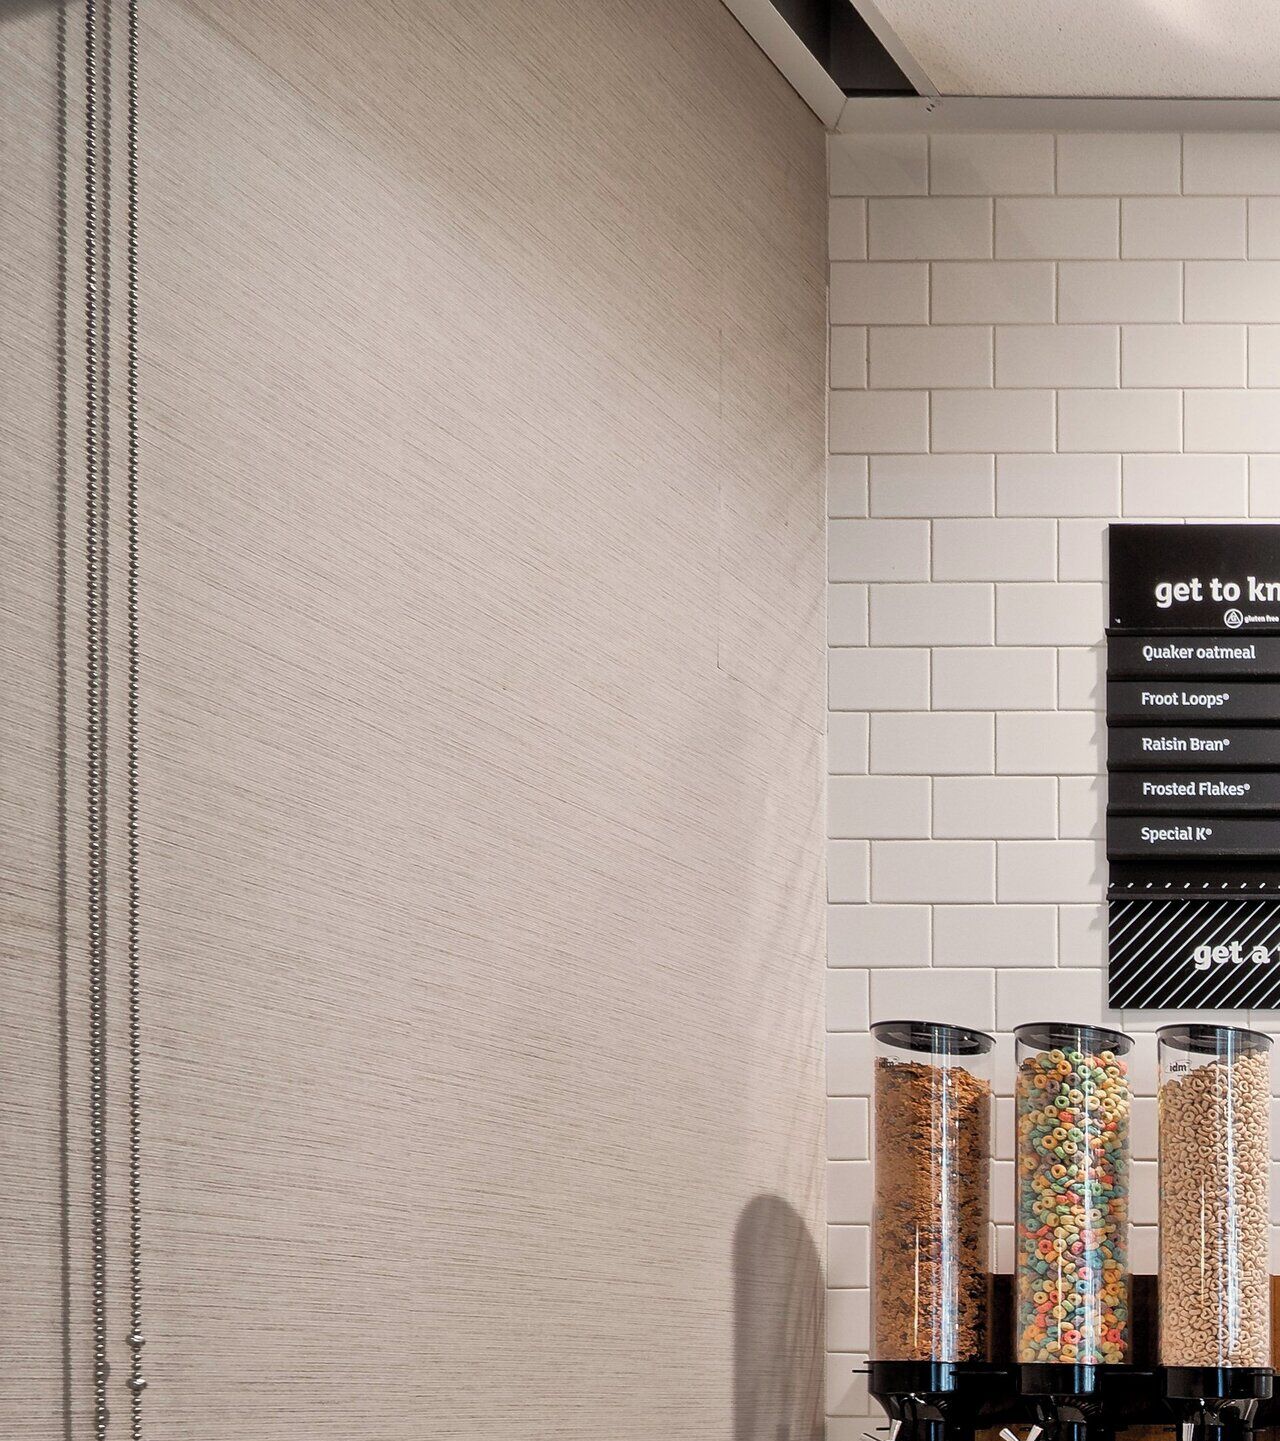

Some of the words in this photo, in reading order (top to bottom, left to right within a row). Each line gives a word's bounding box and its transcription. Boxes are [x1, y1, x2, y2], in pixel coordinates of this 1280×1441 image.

[1155, 578, 1202, 608] get
[1210, 578, 1240, 601] to
[1143, 645, 1194, 661] Quaker
[1197, 645, 1255, 659] oatmeal
[1142, 692, 1178, 705] Froot
[1142, 737, 1186, 750] Raisin
[1143, 782, 1195, 795] Frosted
[1142, 827, 1192, 843] Special
[1193, 941, 1243, 970] get
[1252, 941, 1269, 964] a
